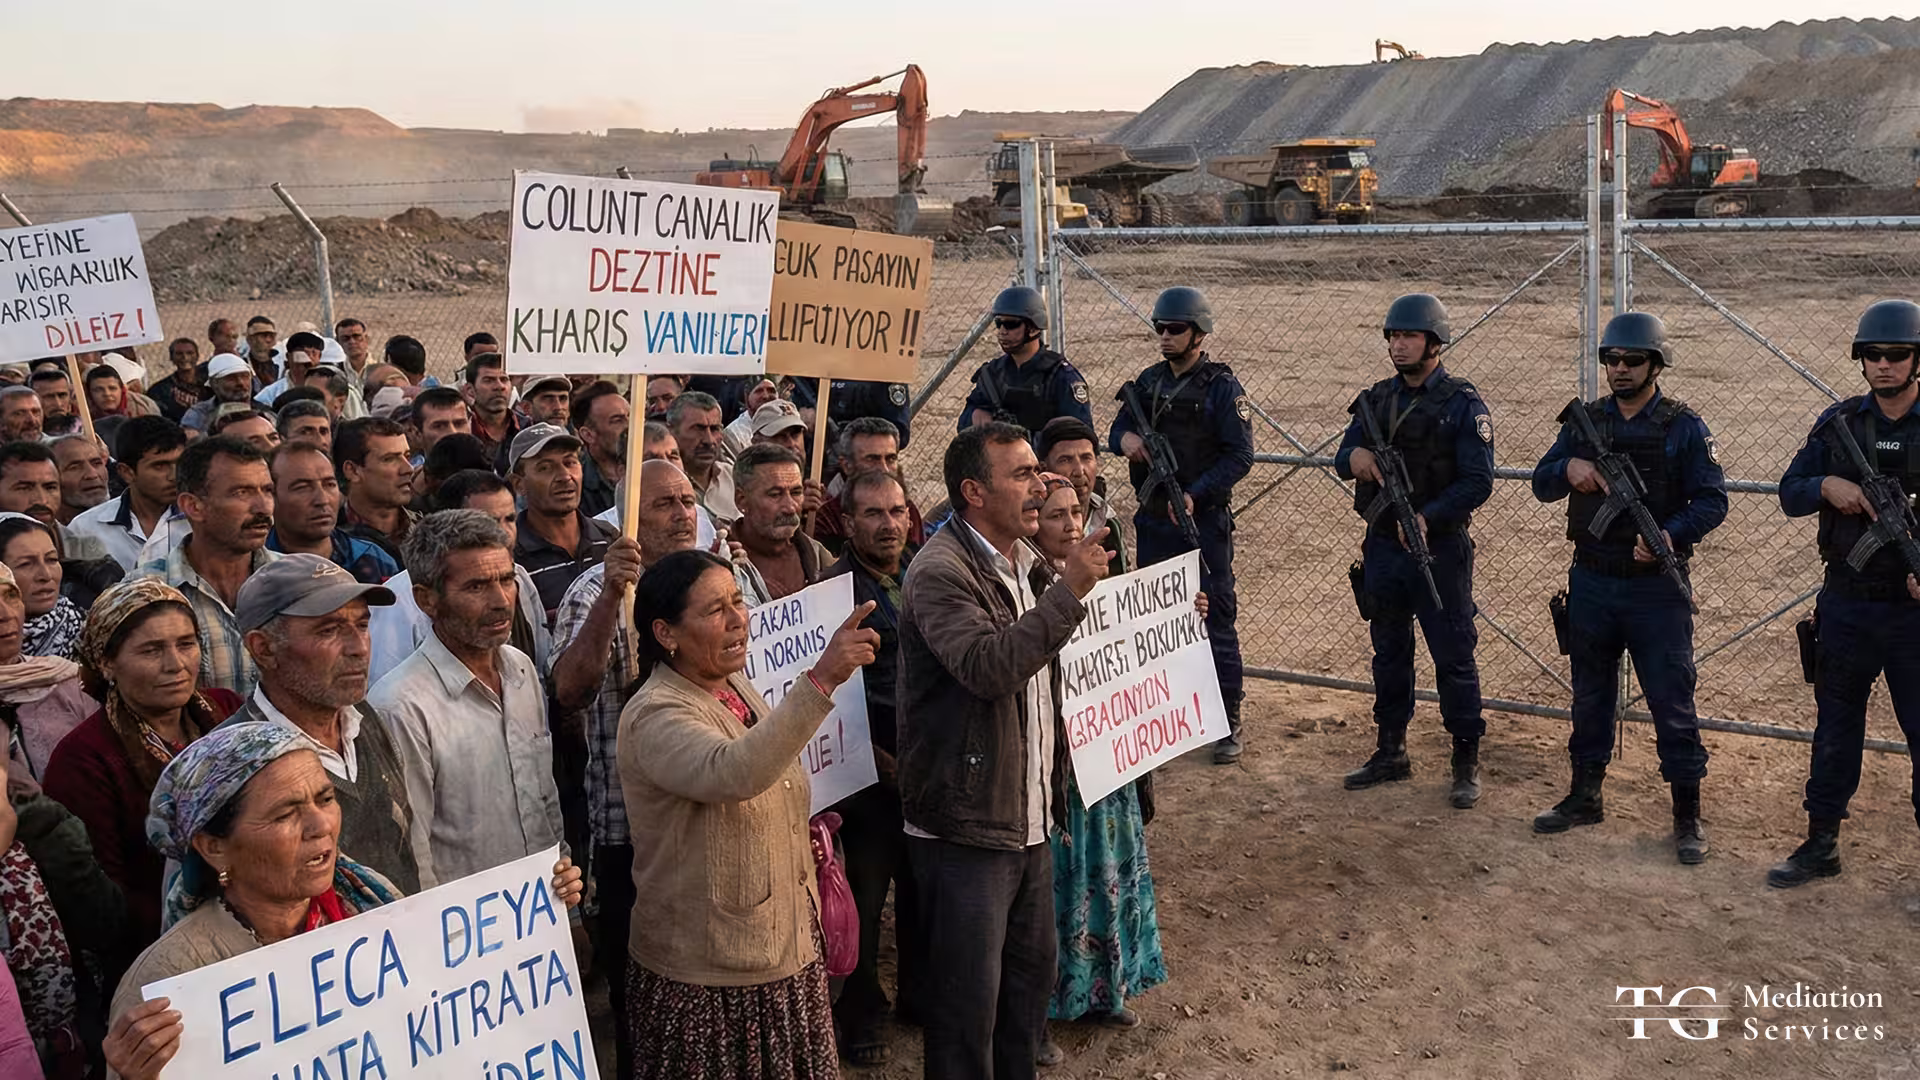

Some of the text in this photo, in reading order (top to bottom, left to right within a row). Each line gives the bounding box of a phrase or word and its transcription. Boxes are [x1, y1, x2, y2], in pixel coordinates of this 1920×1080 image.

[522, 182, 775, 244] COLUNT CANALIK
[0, 228, 91, 262] YEFİNE
[589, 245, 721, 296] DEZTİNE
[833, 246, 920, 291] PASAYIN
[512, 307, 630, 358] KHARIŞ
[898, 308, 921, 357] !!
[219, 876, 557, 1064] ELECA DEYA
[406, 949, 573, 1068] KİTRATA
